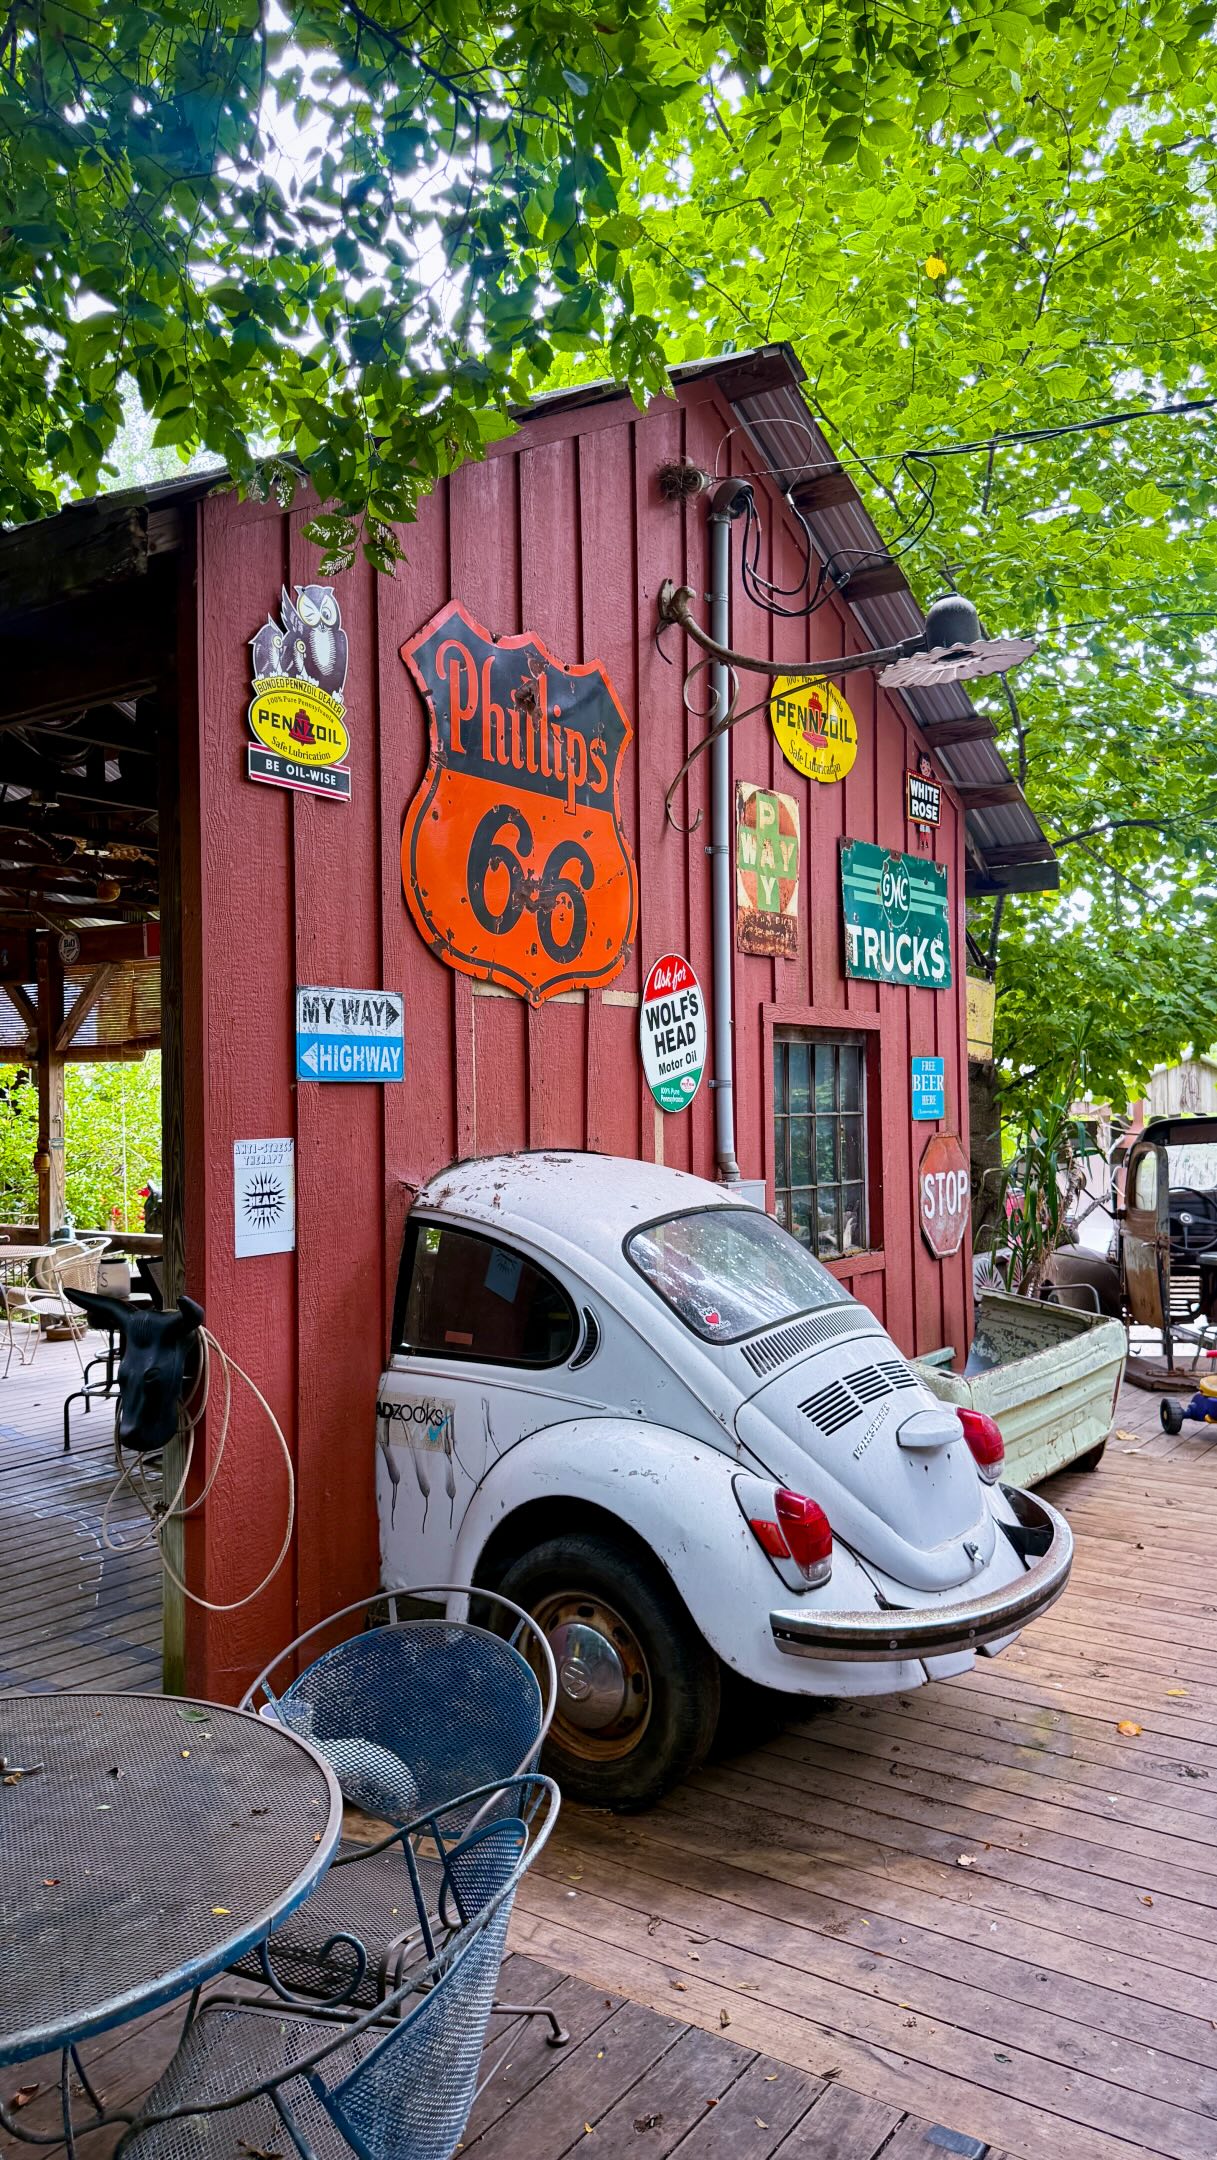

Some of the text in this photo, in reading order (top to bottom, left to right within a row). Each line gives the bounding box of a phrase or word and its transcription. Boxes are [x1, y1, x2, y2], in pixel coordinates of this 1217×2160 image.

[257, 679, 342, 715] BONDED PENNZOIL DEALER
[267, 695, 334, 723] 100% Pure Pennsylvania
[258, 708, 342, 745] PENNZOIL
[435, 639, 608, 816] Phillips
[776, 699, 852, 743] PENNZOIL
[271, 736, 331, 761] Safe Lubrication
[788, 739, 804, 764] Safe
[265, 758, 336, 786] BE OIL-WISE
[910, 778, 939, 804] WHITE
[911, 799, 938, 821] ROSE
[467, 804, 595, 964] 66
[882, 873, 909, 911] GMC
[846, 923, 946, 979] TRUCKS
[653, 961, 687, 991] Ask for
[302, 997, 387, 1027] MY WAY
[645, 990, 699, 1032] WOLF'S
[654, 1021, 697, 1057] HEAD
[319, 1044, 401, 1073] HIGHWAY
[658, 1050, 697, 1076] Motor Oil
[921, 1060, 936, 1071] FREE
[911, 1074, 944, 1092] BEER
[921, 1094, 937, 1106] HERE
[235, 1142, 293, 1155] ANTI-STRESS
[243, 1153, 284, 1166] THERAPY
[248, 1194, 279, 1206] HEAD
[924, 1169, 968, 1220] STOP
[250, 1207, 277, 1219] HERE
